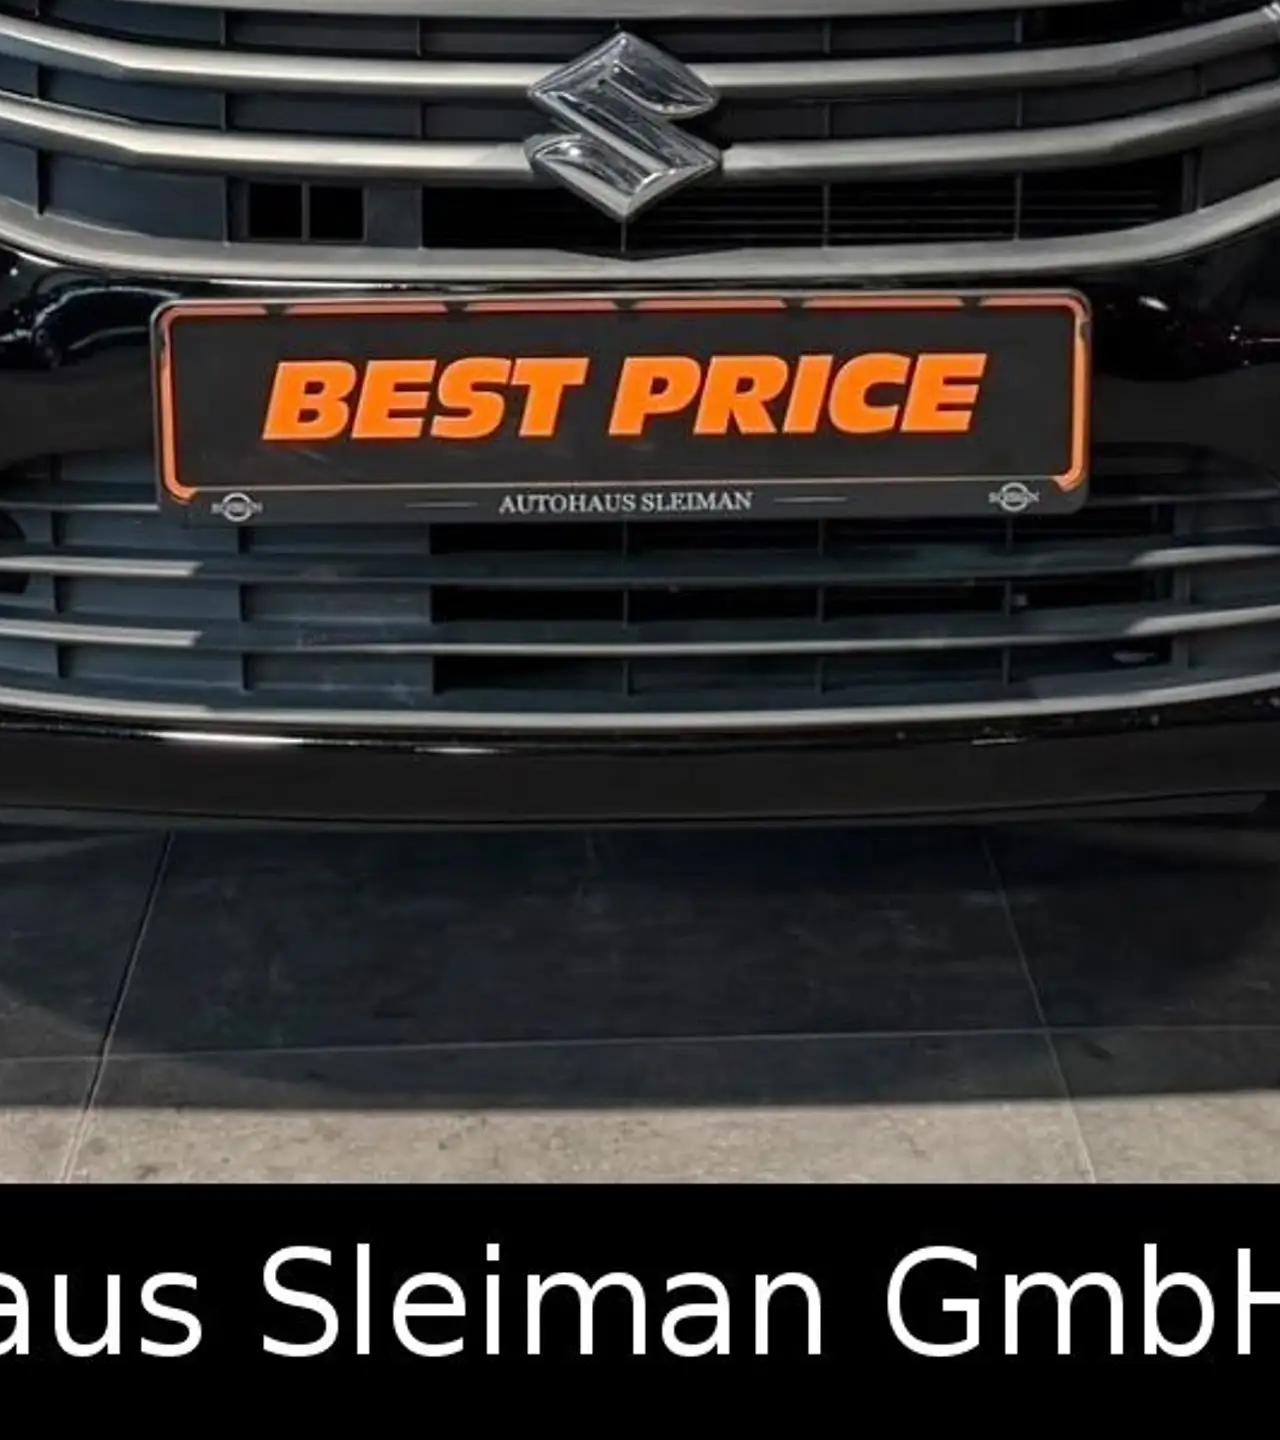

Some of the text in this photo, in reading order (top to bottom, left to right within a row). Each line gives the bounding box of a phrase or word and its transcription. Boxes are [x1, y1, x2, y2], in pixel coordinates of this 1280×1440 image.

[262, 352, 988, 441] BEST PRICE
[498, 491, 754, 515] AUTOHAUS SLEIMAN
